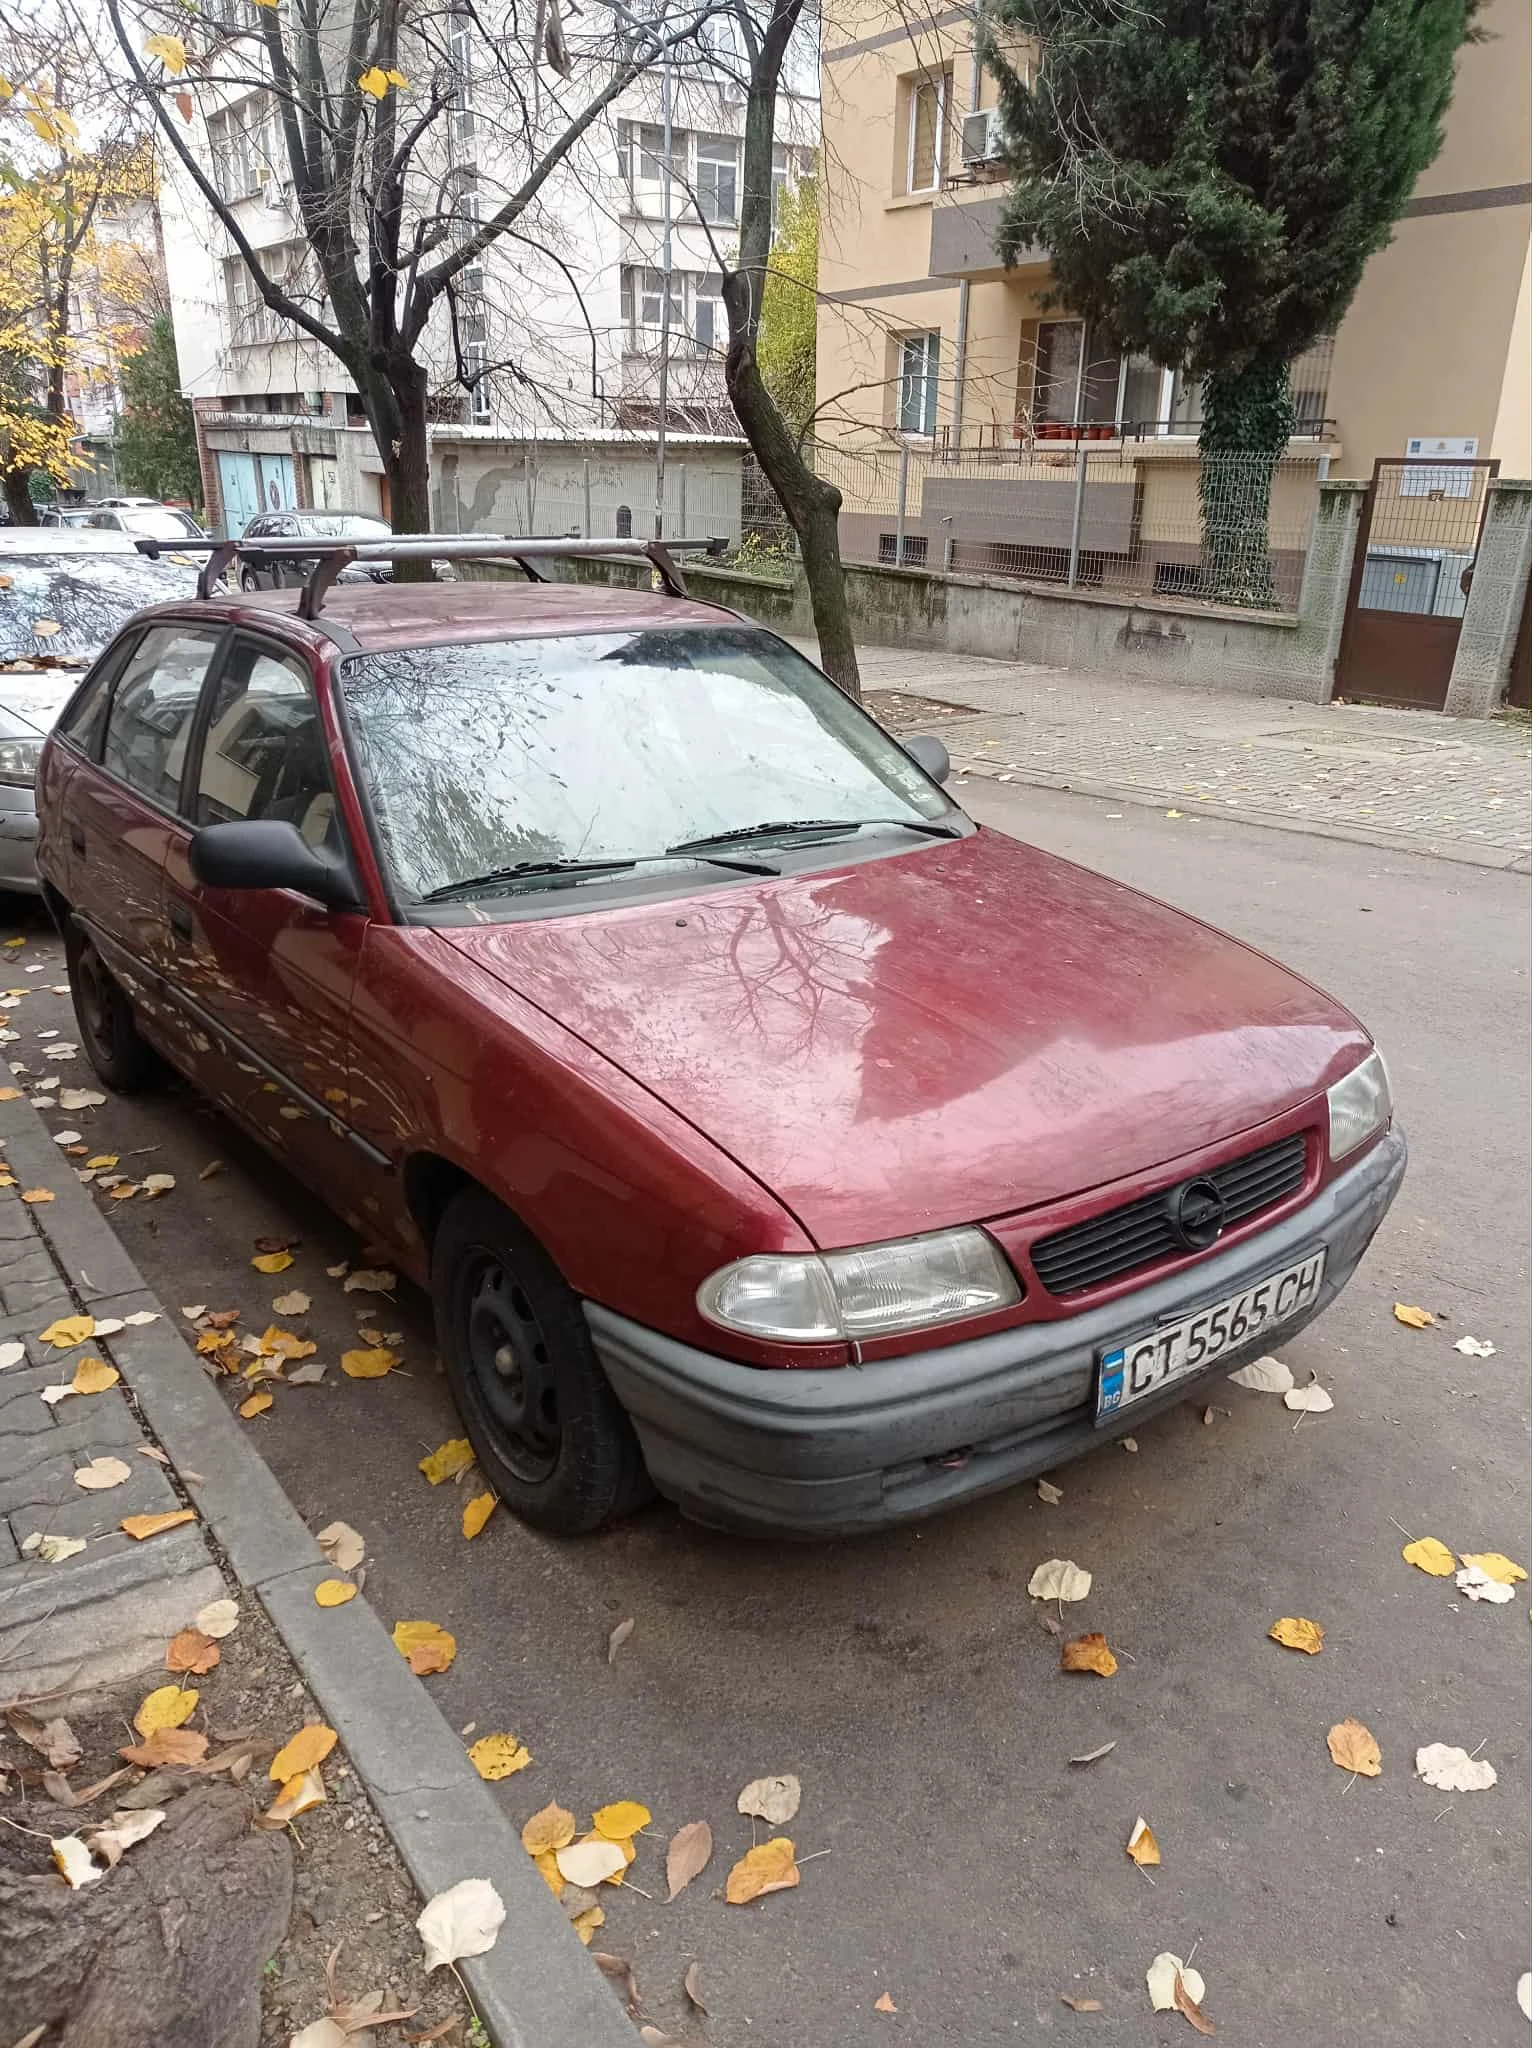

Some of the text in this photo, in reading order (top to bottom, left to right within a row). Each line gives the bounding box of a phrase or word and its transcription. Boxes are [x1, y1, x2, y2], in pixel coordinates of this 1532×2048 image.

[1129, 1330, 1182, 1395] CT
[1186, 1285, 1271, 1366] 5565
[1103, 1390, 1121, 1409] BG
